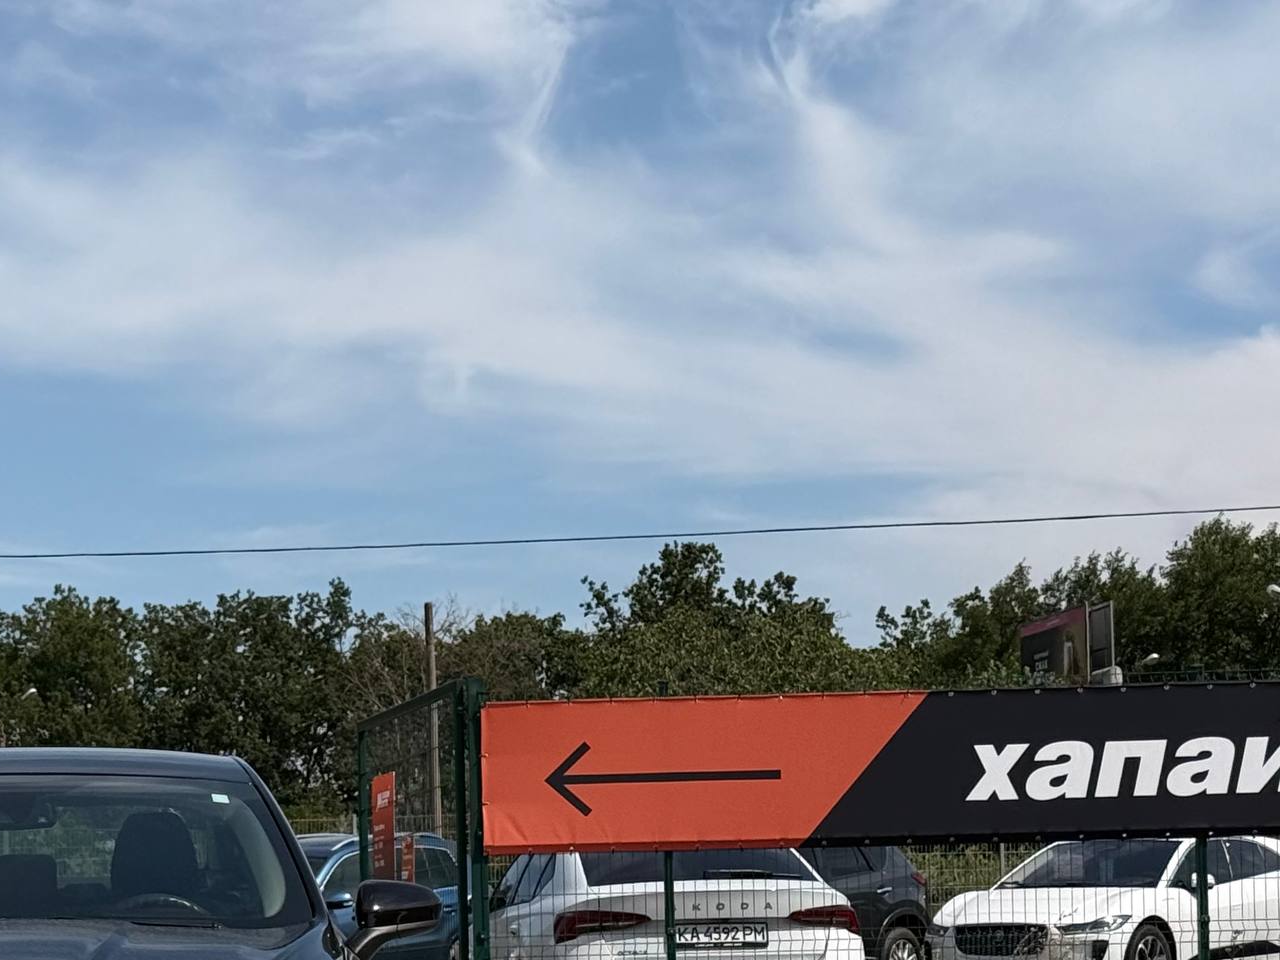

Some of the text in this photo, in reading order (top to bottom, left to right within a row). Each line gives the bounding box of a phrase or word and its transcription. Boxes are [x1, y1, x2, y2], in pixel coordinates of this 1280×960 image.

[673, 902, 773, 911] KODA
[677, 926, 766, 942] KA 4592 PM
